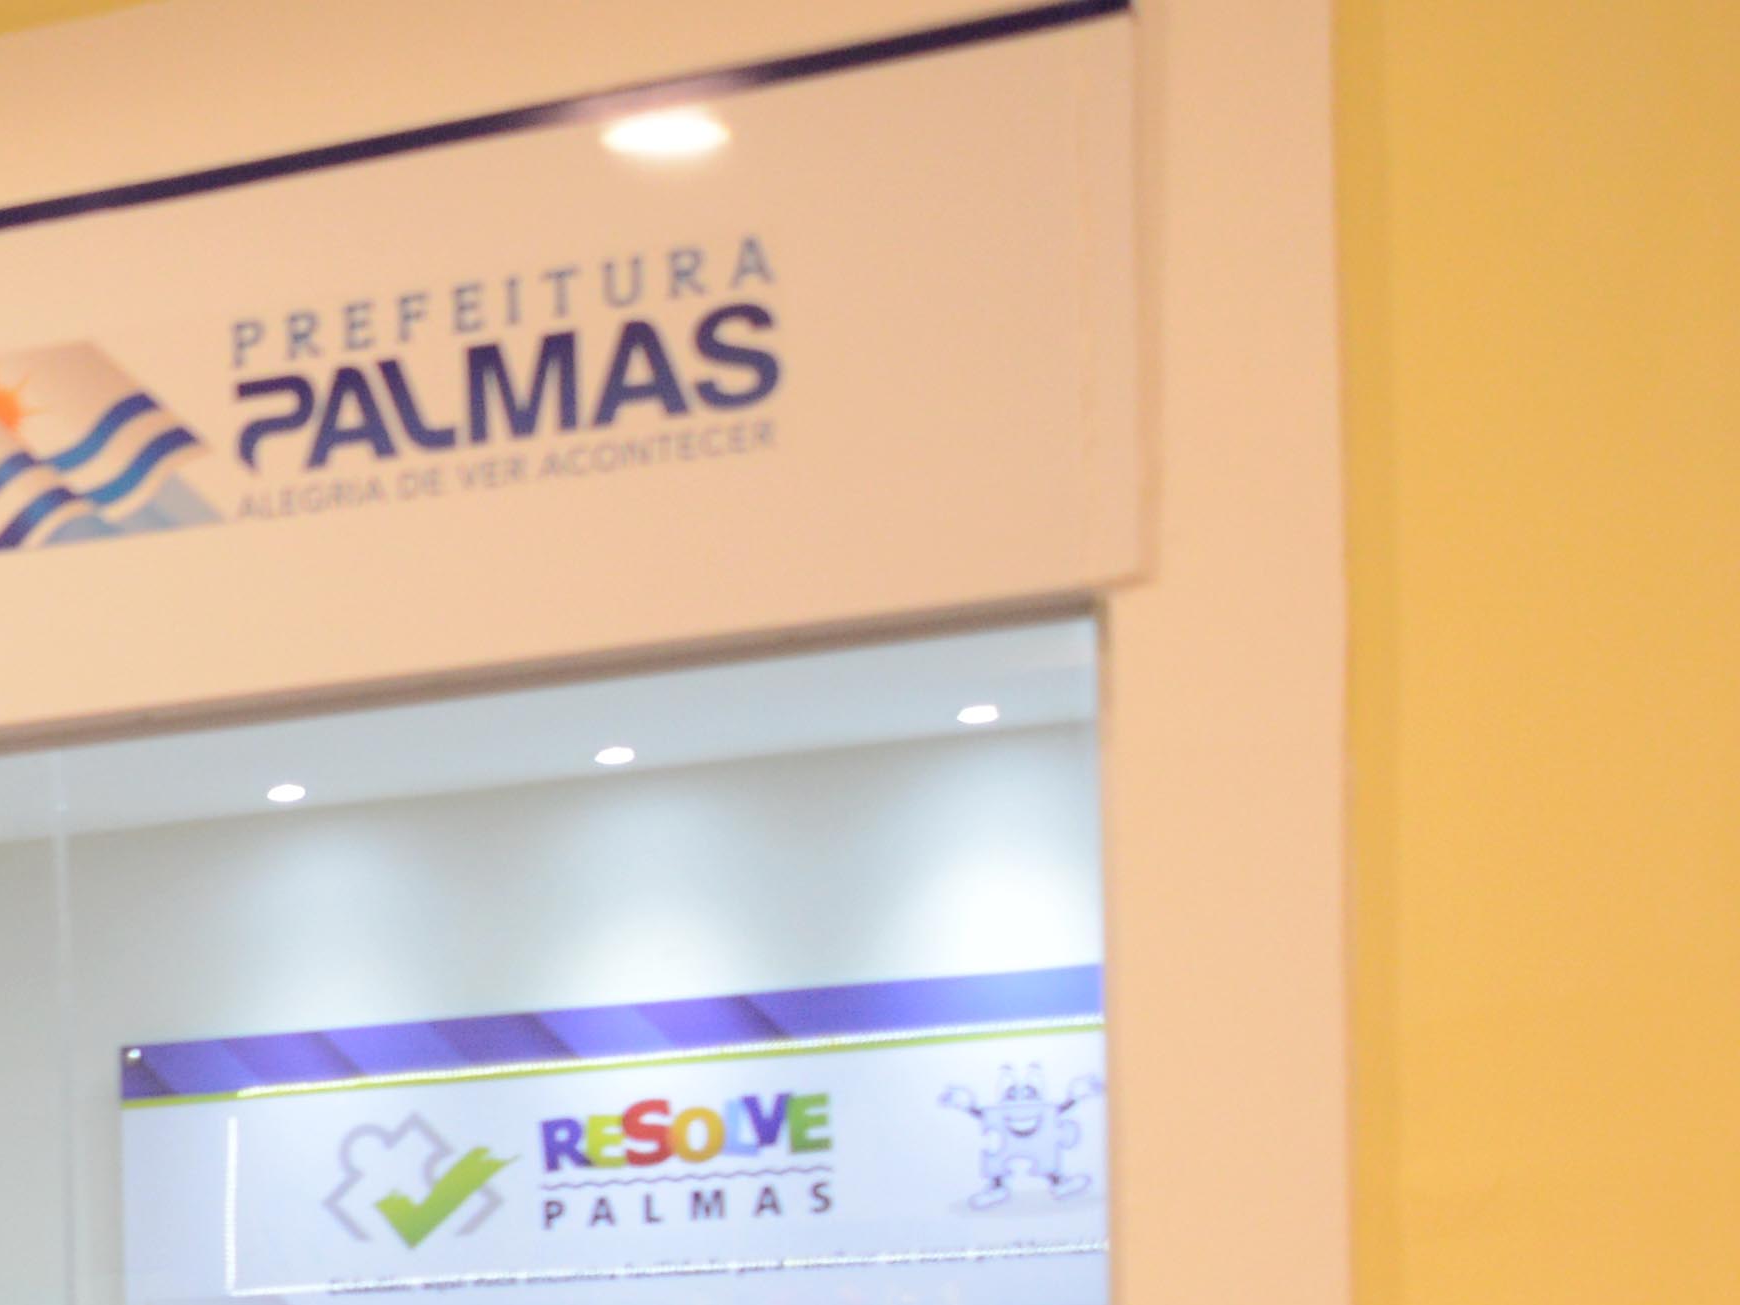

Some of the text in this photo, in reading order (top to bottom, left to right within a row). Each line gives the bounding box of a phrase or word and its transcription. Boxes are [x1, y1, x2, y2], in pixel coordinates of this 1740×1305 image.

[230, 236, 775, 368] PREFEITURA
[236, 303, 781, 475] PALMAS
[237, 420, 778, 522] ALEGRIA DE VER ACONTECER
[540, 1091, 833, 1173] RESOLVE
[543, 1181, 833, 1231] PALMAS
